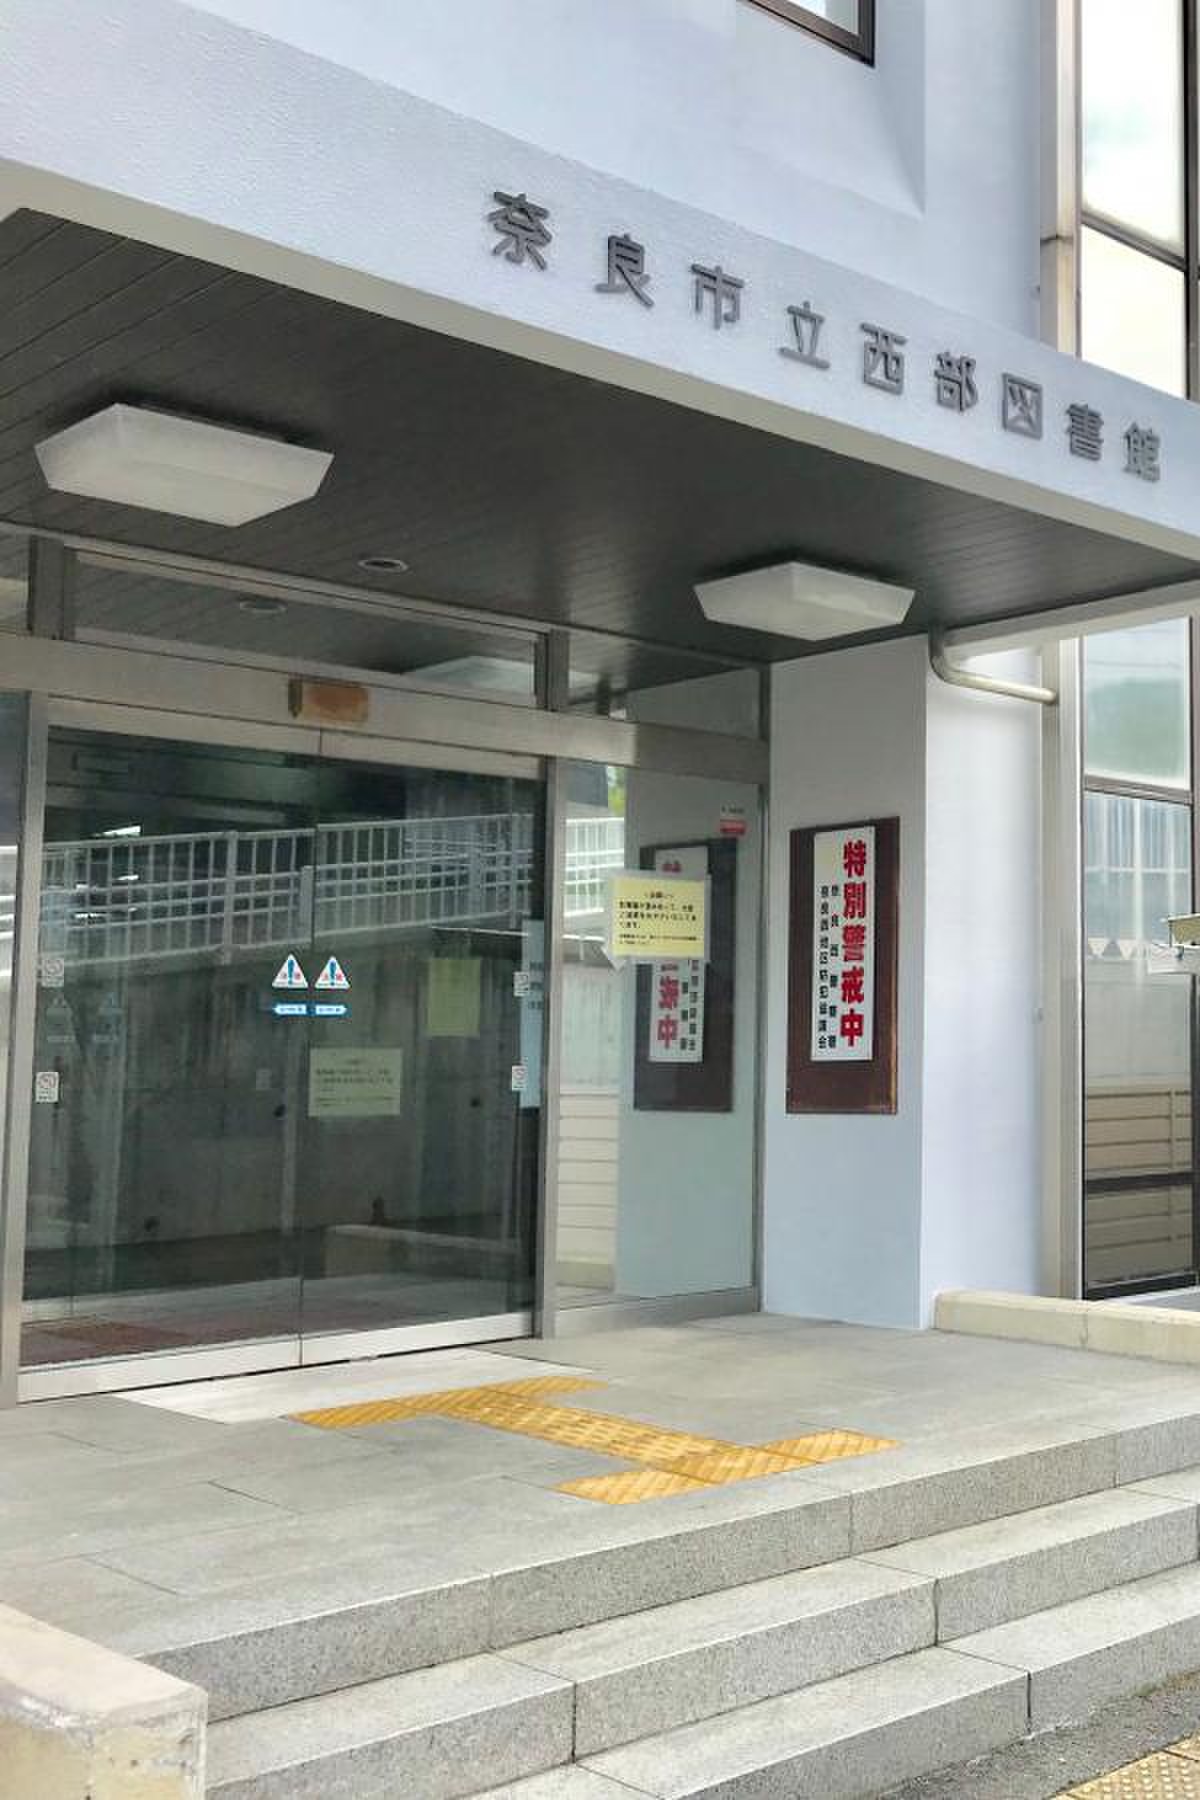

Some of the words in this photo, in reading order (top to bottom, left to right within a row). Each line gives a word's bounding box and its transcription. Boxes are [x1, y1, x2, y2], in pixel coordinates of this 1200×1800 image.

[487, 192, 1161, 482] 奈良市立西部図書館
[840, 840, 867, 1047] 特別警戒中
